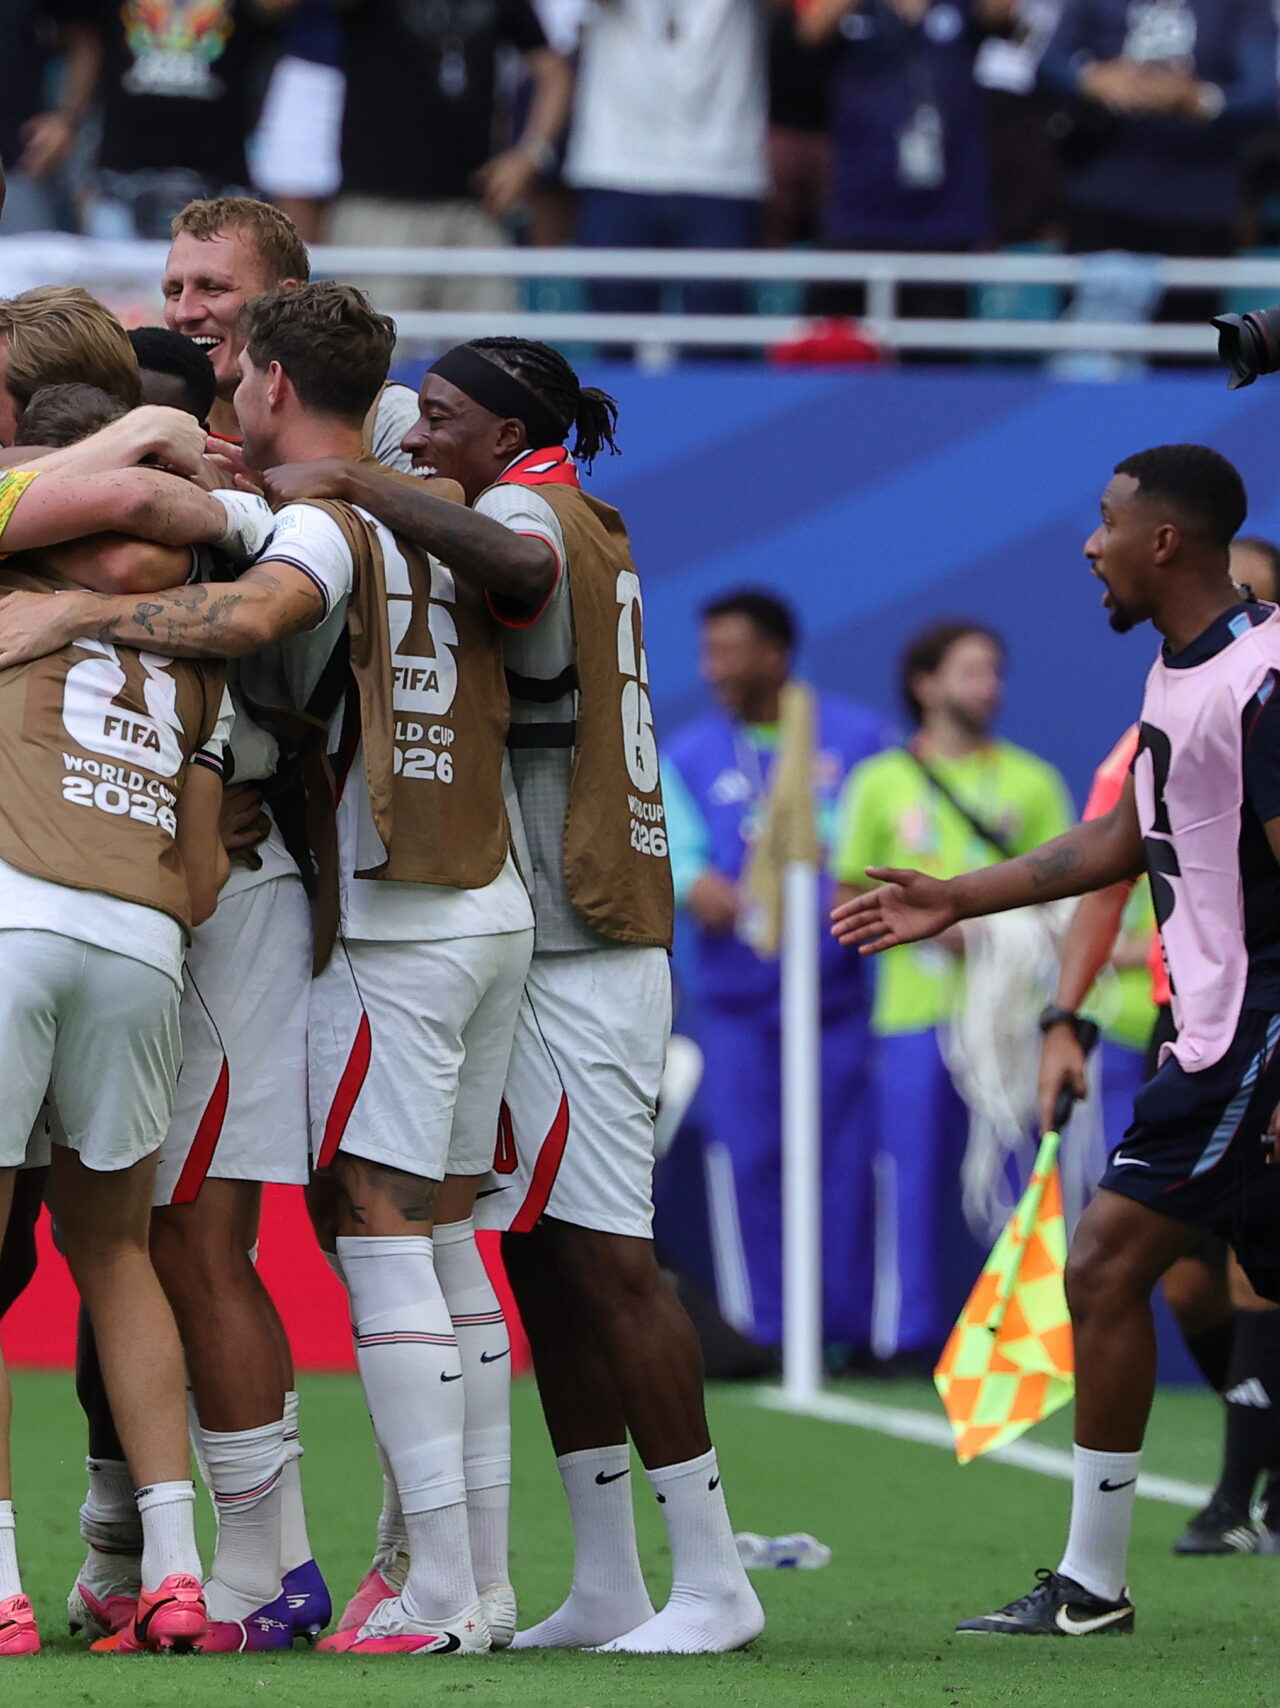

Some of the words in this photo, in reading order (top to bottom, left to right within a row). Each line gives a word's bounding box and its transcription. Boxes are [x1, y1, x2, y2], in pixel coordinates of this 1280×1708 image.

[103, 715, 161, 753] FIFA
[428, 725, 455, 747] CUP
[61, 752, 145, 792] WORLD
[146, 780, 177, 808] CUP
[61, 775, 177, 840] 2026
[643, 802, 663, 822] CUP
